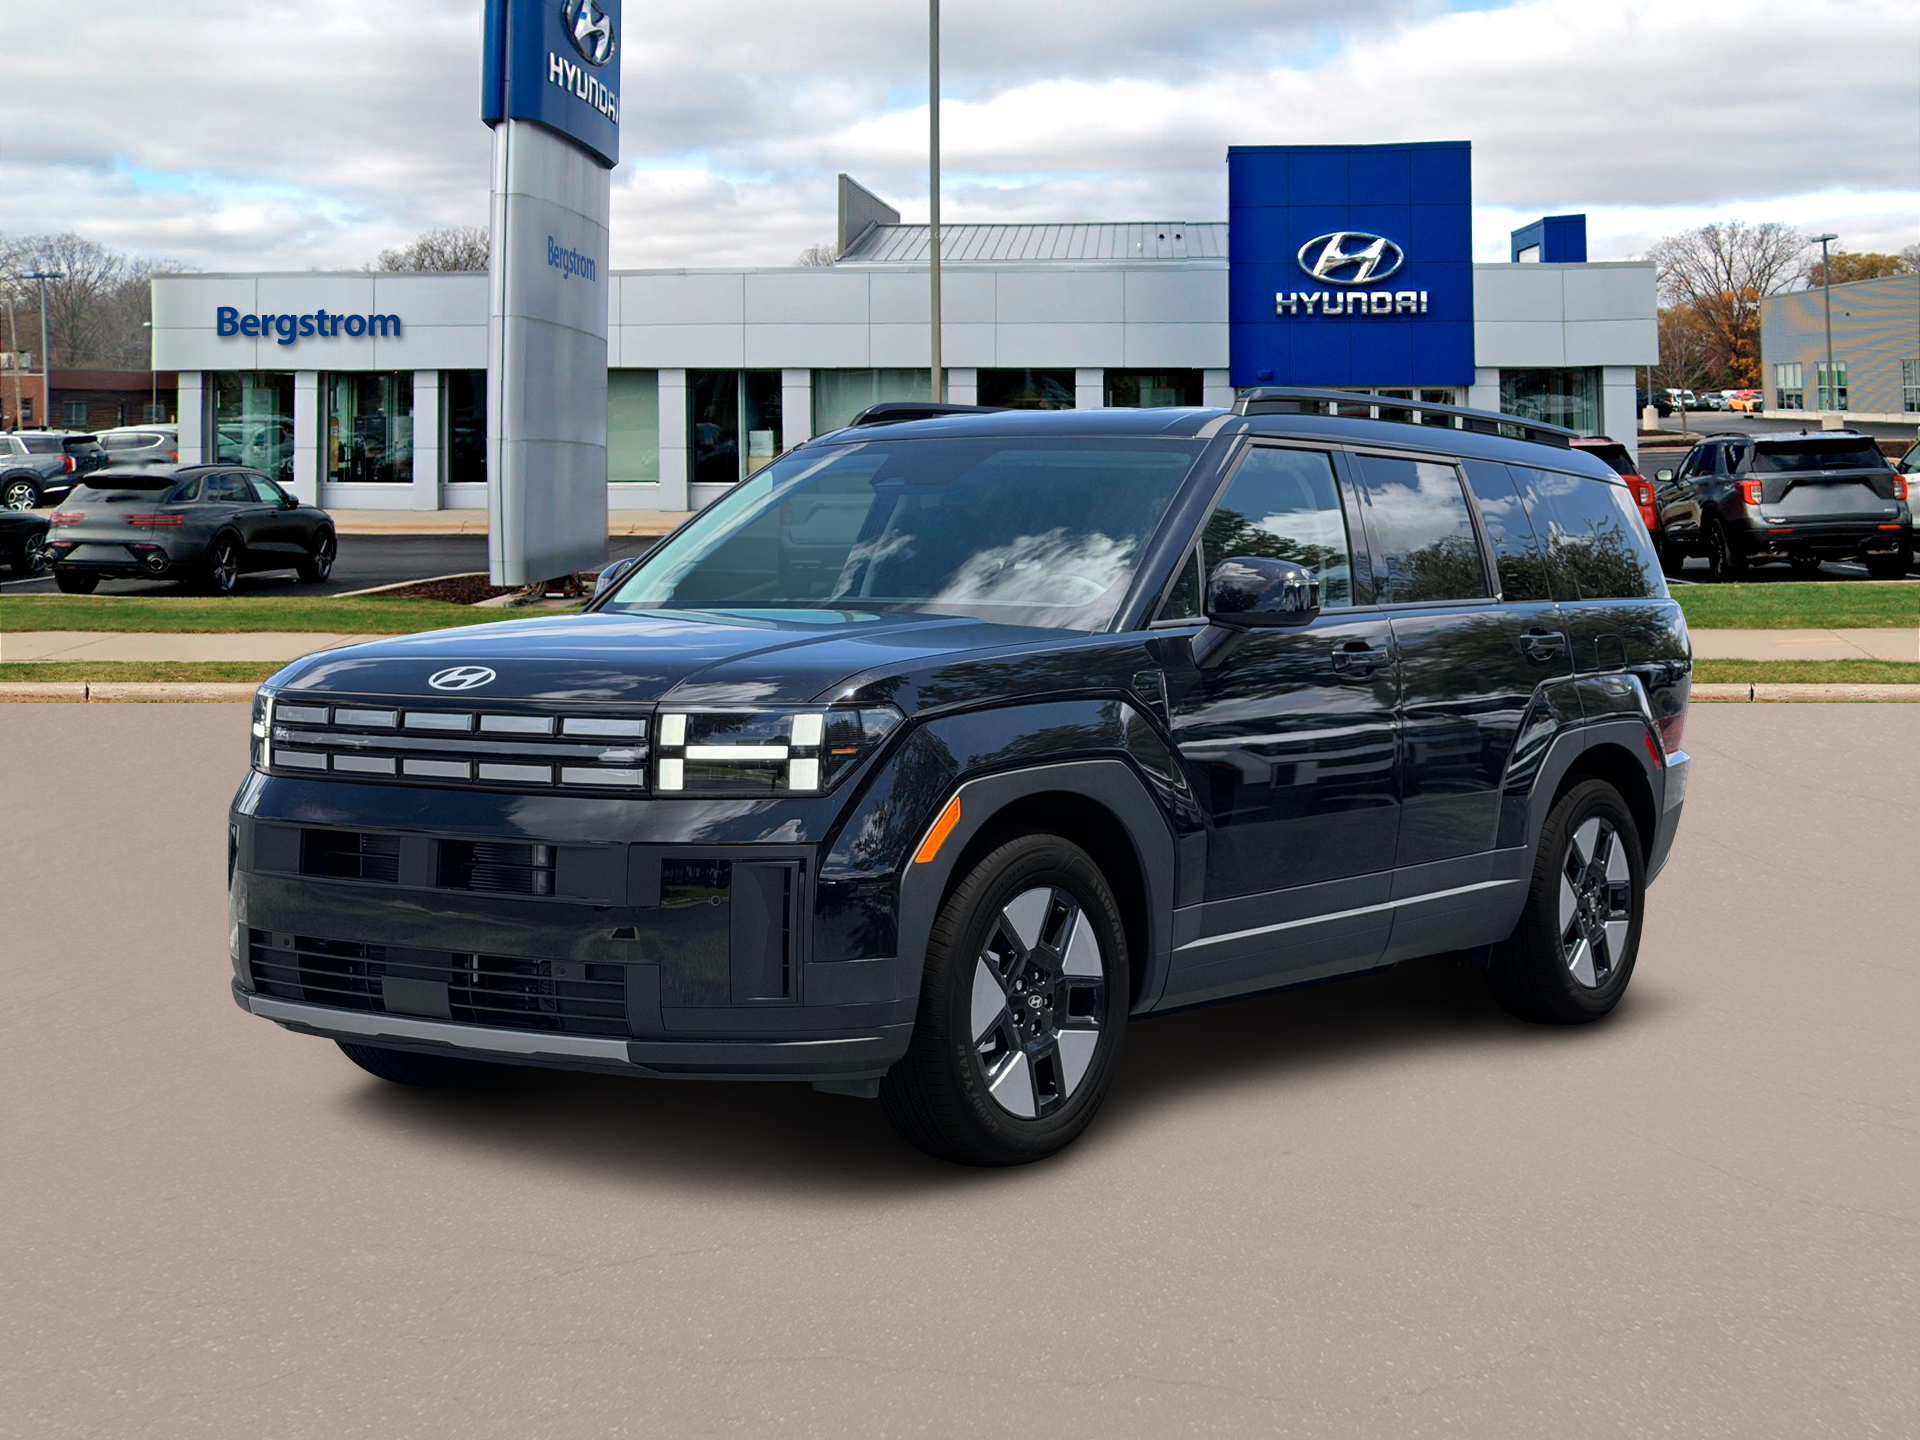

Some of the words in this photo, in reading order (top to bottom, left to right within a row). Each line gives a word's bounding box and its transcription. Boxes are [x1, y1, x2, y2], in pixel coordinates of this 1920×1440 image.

[549, 51, 619, 125] HYUNDAI
[547, 235, 596, 282] Bergstrom
[217, 306, 402, 346] Bergstrom
[1275, 290, 1429, 316] HYUNDAI
[1089, 878, 1126, 964] ASSURANCE
[957, 1043, 999, 1133] GOODYEAR
